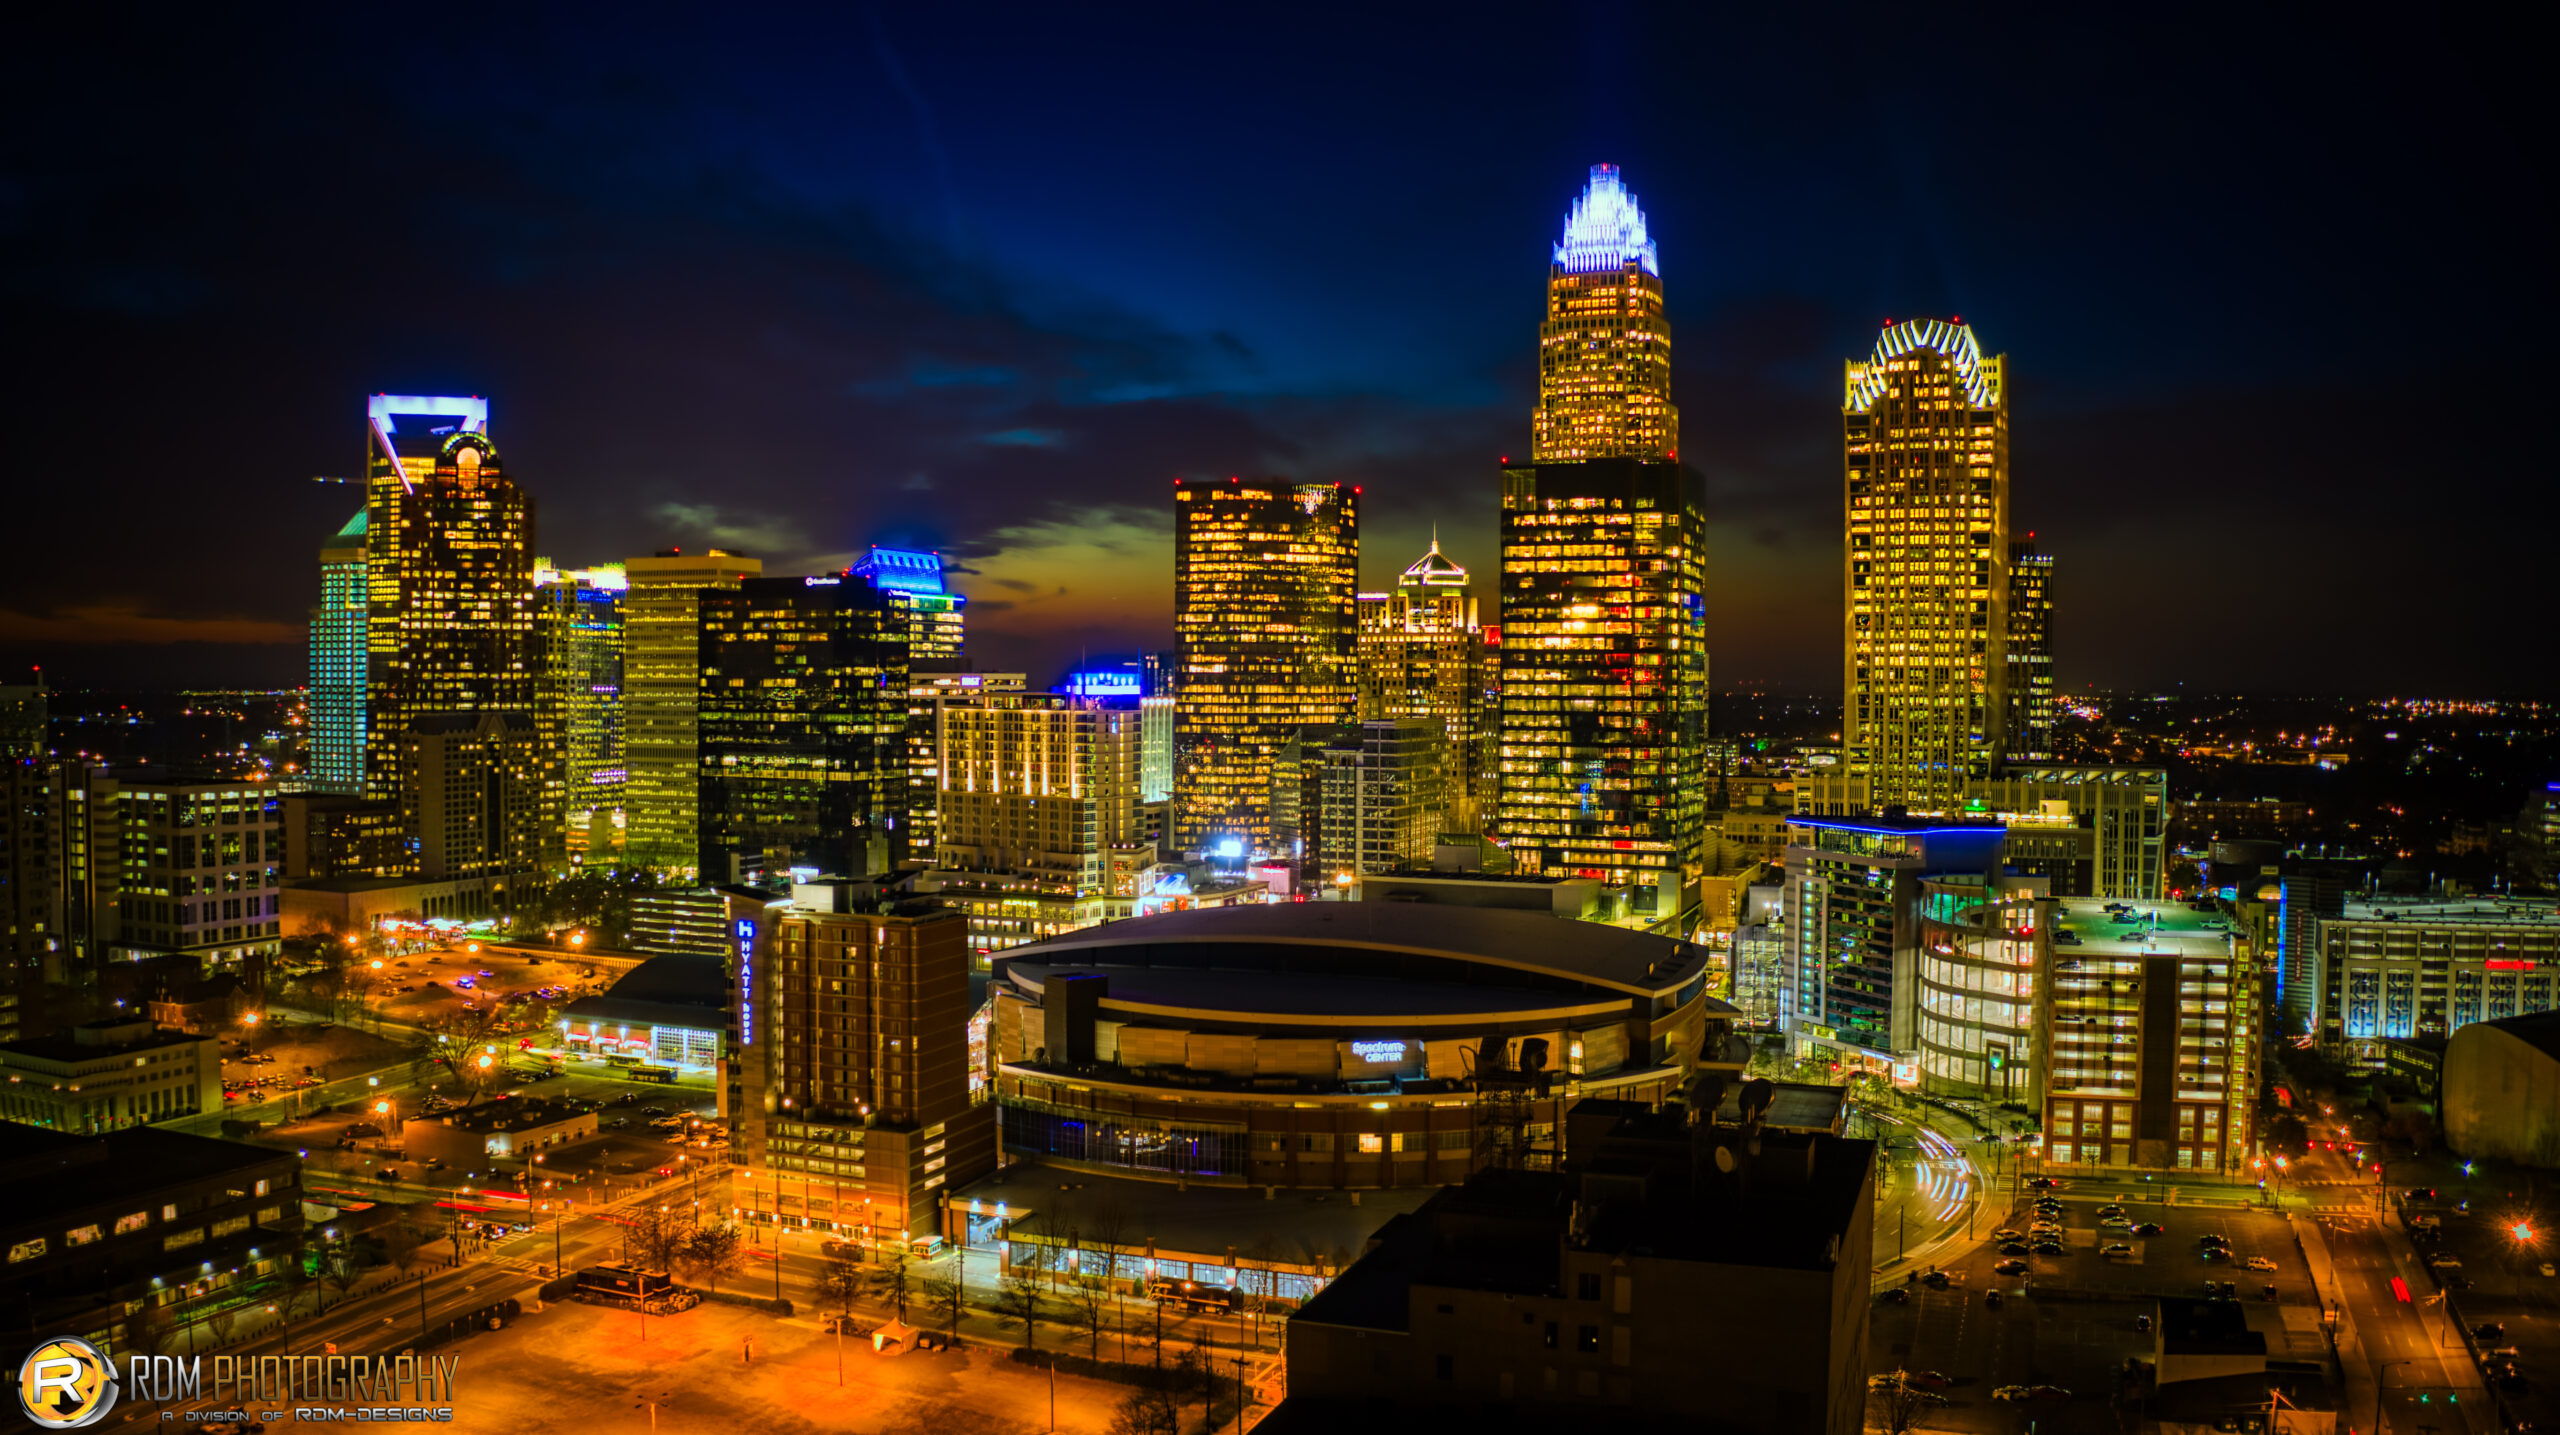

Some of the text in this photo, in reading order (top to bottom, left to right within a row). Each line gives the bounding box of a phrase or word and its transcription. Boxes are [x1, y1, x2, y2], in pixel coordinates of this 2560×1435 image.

[741, 940, 752, 1044] HYATT house
[1352, 1041, 1401, 1056] Spectrum
[1365, 1052, 1402, 1062] CENTER
